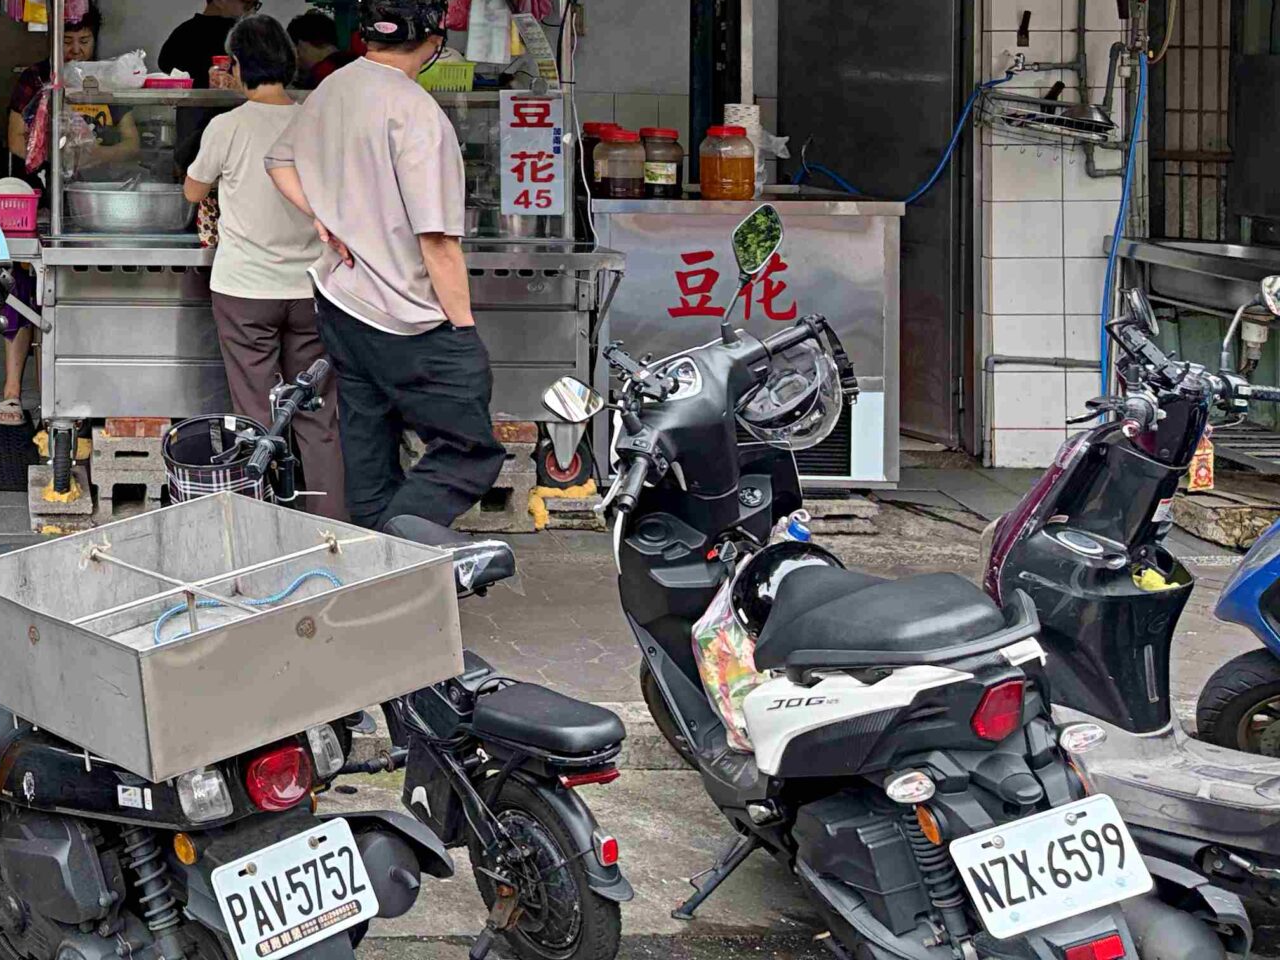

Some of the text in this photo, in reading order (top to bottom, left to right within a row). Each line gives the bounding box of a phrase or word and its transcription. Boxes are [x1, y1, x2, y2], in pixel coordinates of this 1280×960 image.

[510, 95, 555, 183] 豆花
[513, 189, 553, 209] 45
[667, 250, 797, 321] 豆花
[766, 696, 826, 711] JOG
